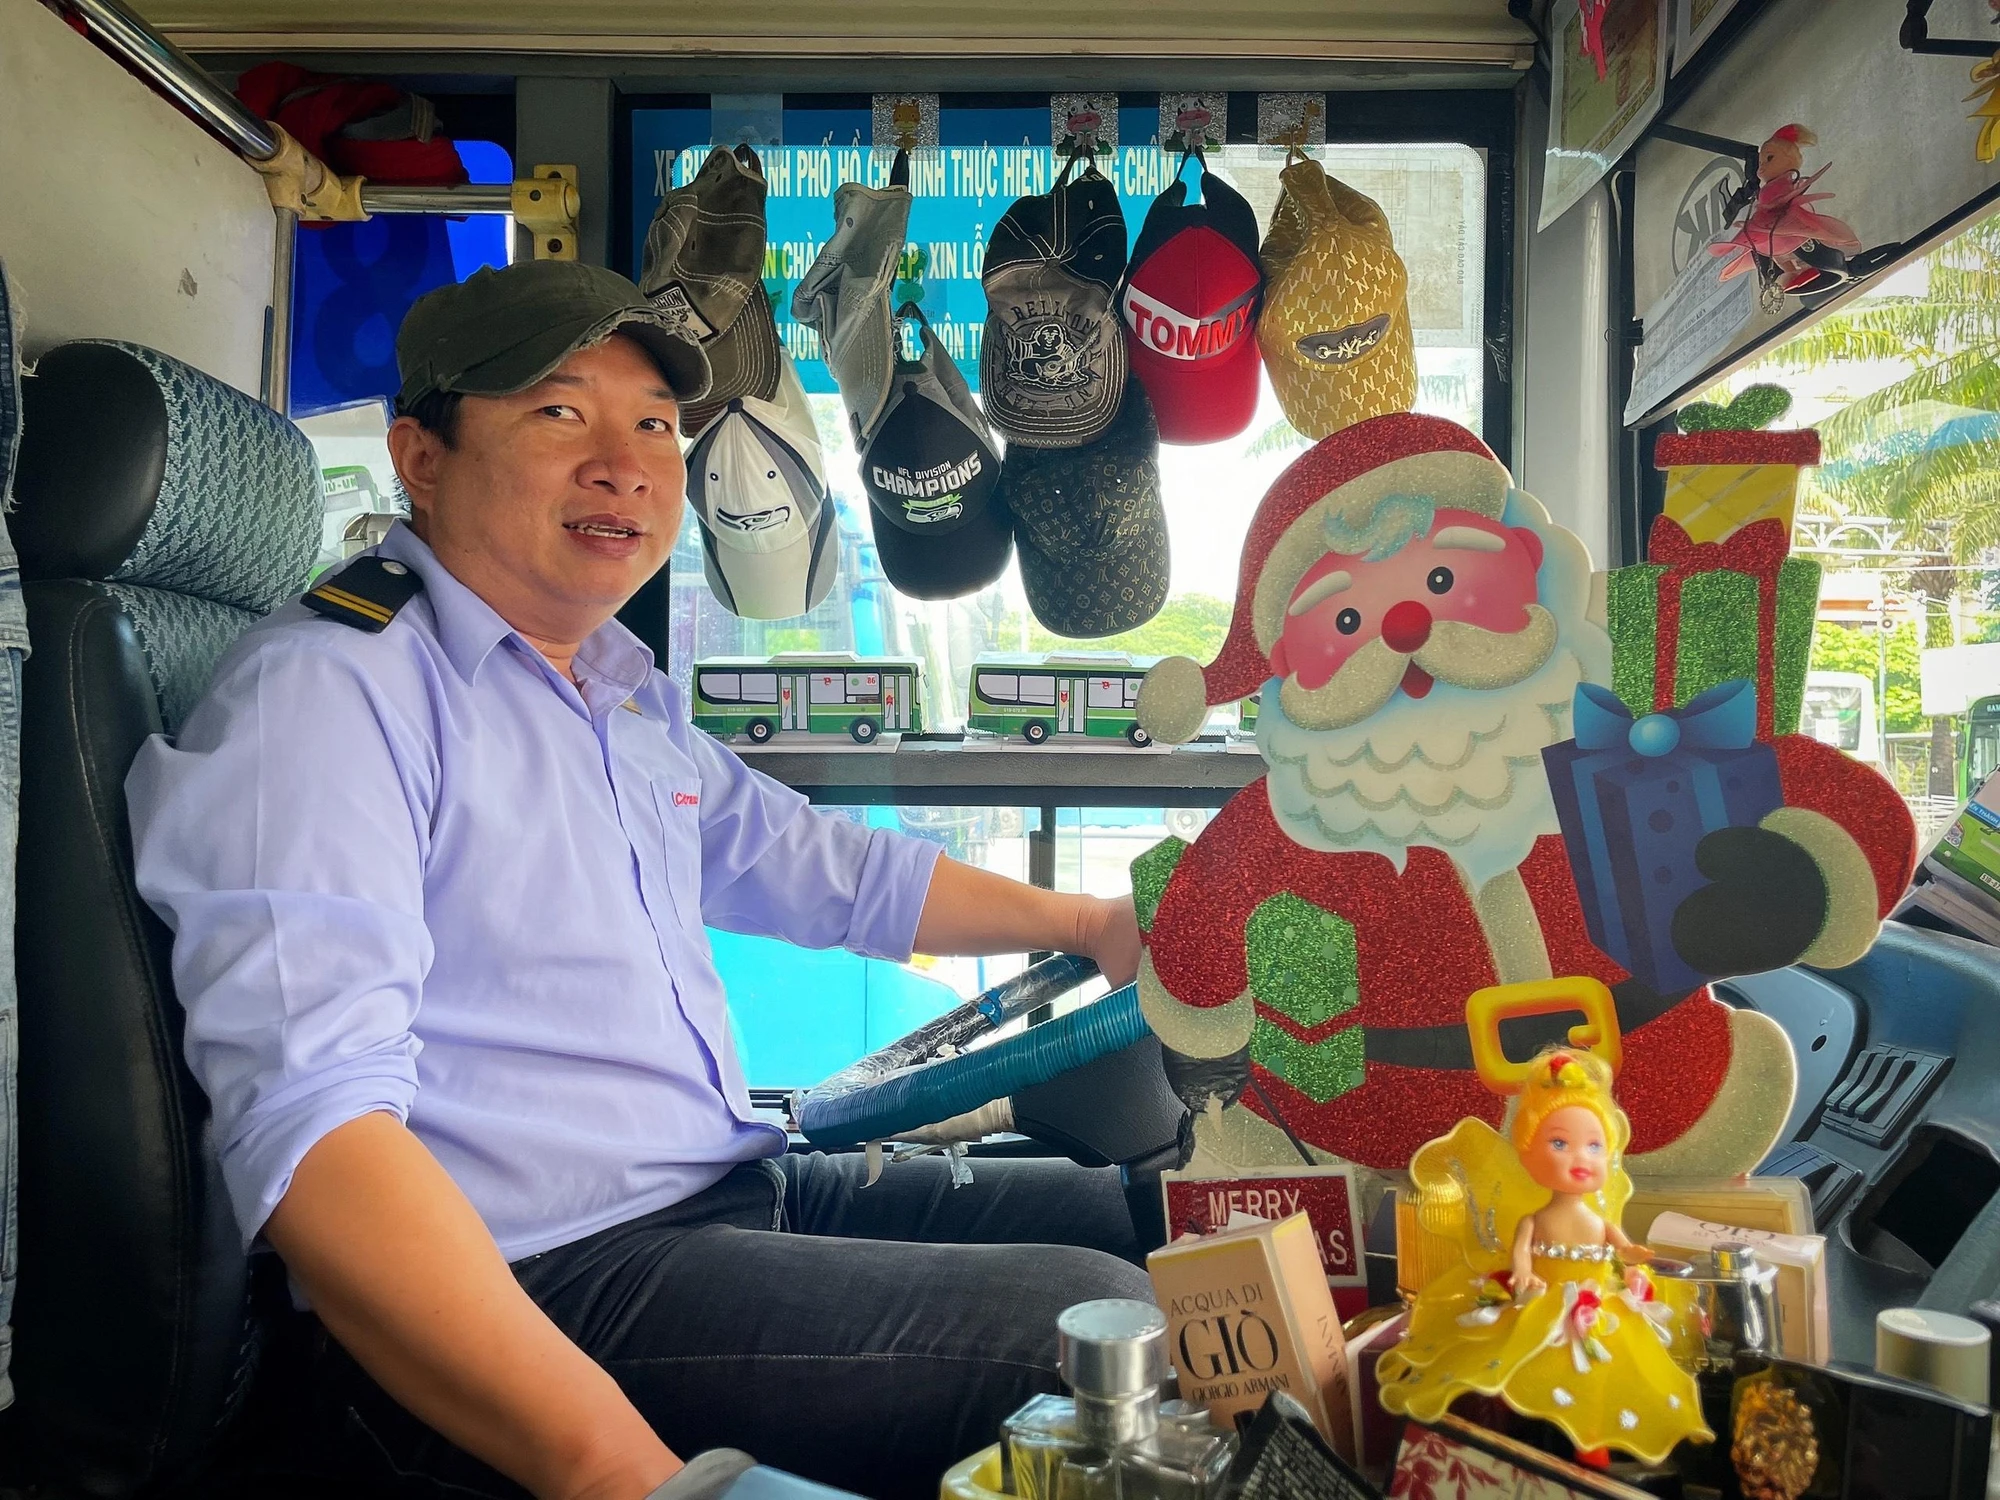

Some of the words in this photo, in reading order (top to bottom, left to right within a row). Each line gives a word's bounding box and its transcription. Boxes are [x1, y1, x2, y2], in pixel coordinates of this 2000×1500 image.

[797, 130, 833, 198] PHỐ
[867, 148, 897, 188] CH
[1208, 188, 1300, 225] MERRY
[929, 241, 957, 280] XIN
[964, 223, 986, 280] LỖ
[1130, 297, 1254, 358] TOMMY
[872, 450, 982, 498] CHAMPIONS
[897, 466, 912, 479] NFL
[915, 460, 952, 480] DIVISION
[866, 676, 876, 685] 86
[1170, 1288, 1239, 1318] ACQUA
[1242, 1283, 1264, 1303] DI
[1178, 1309, 1279, 1381] GIÒ
[1192, 1382, 1240, 1401] GIORGIO
[1243, 1373, 1290, 1396] ARMANI
